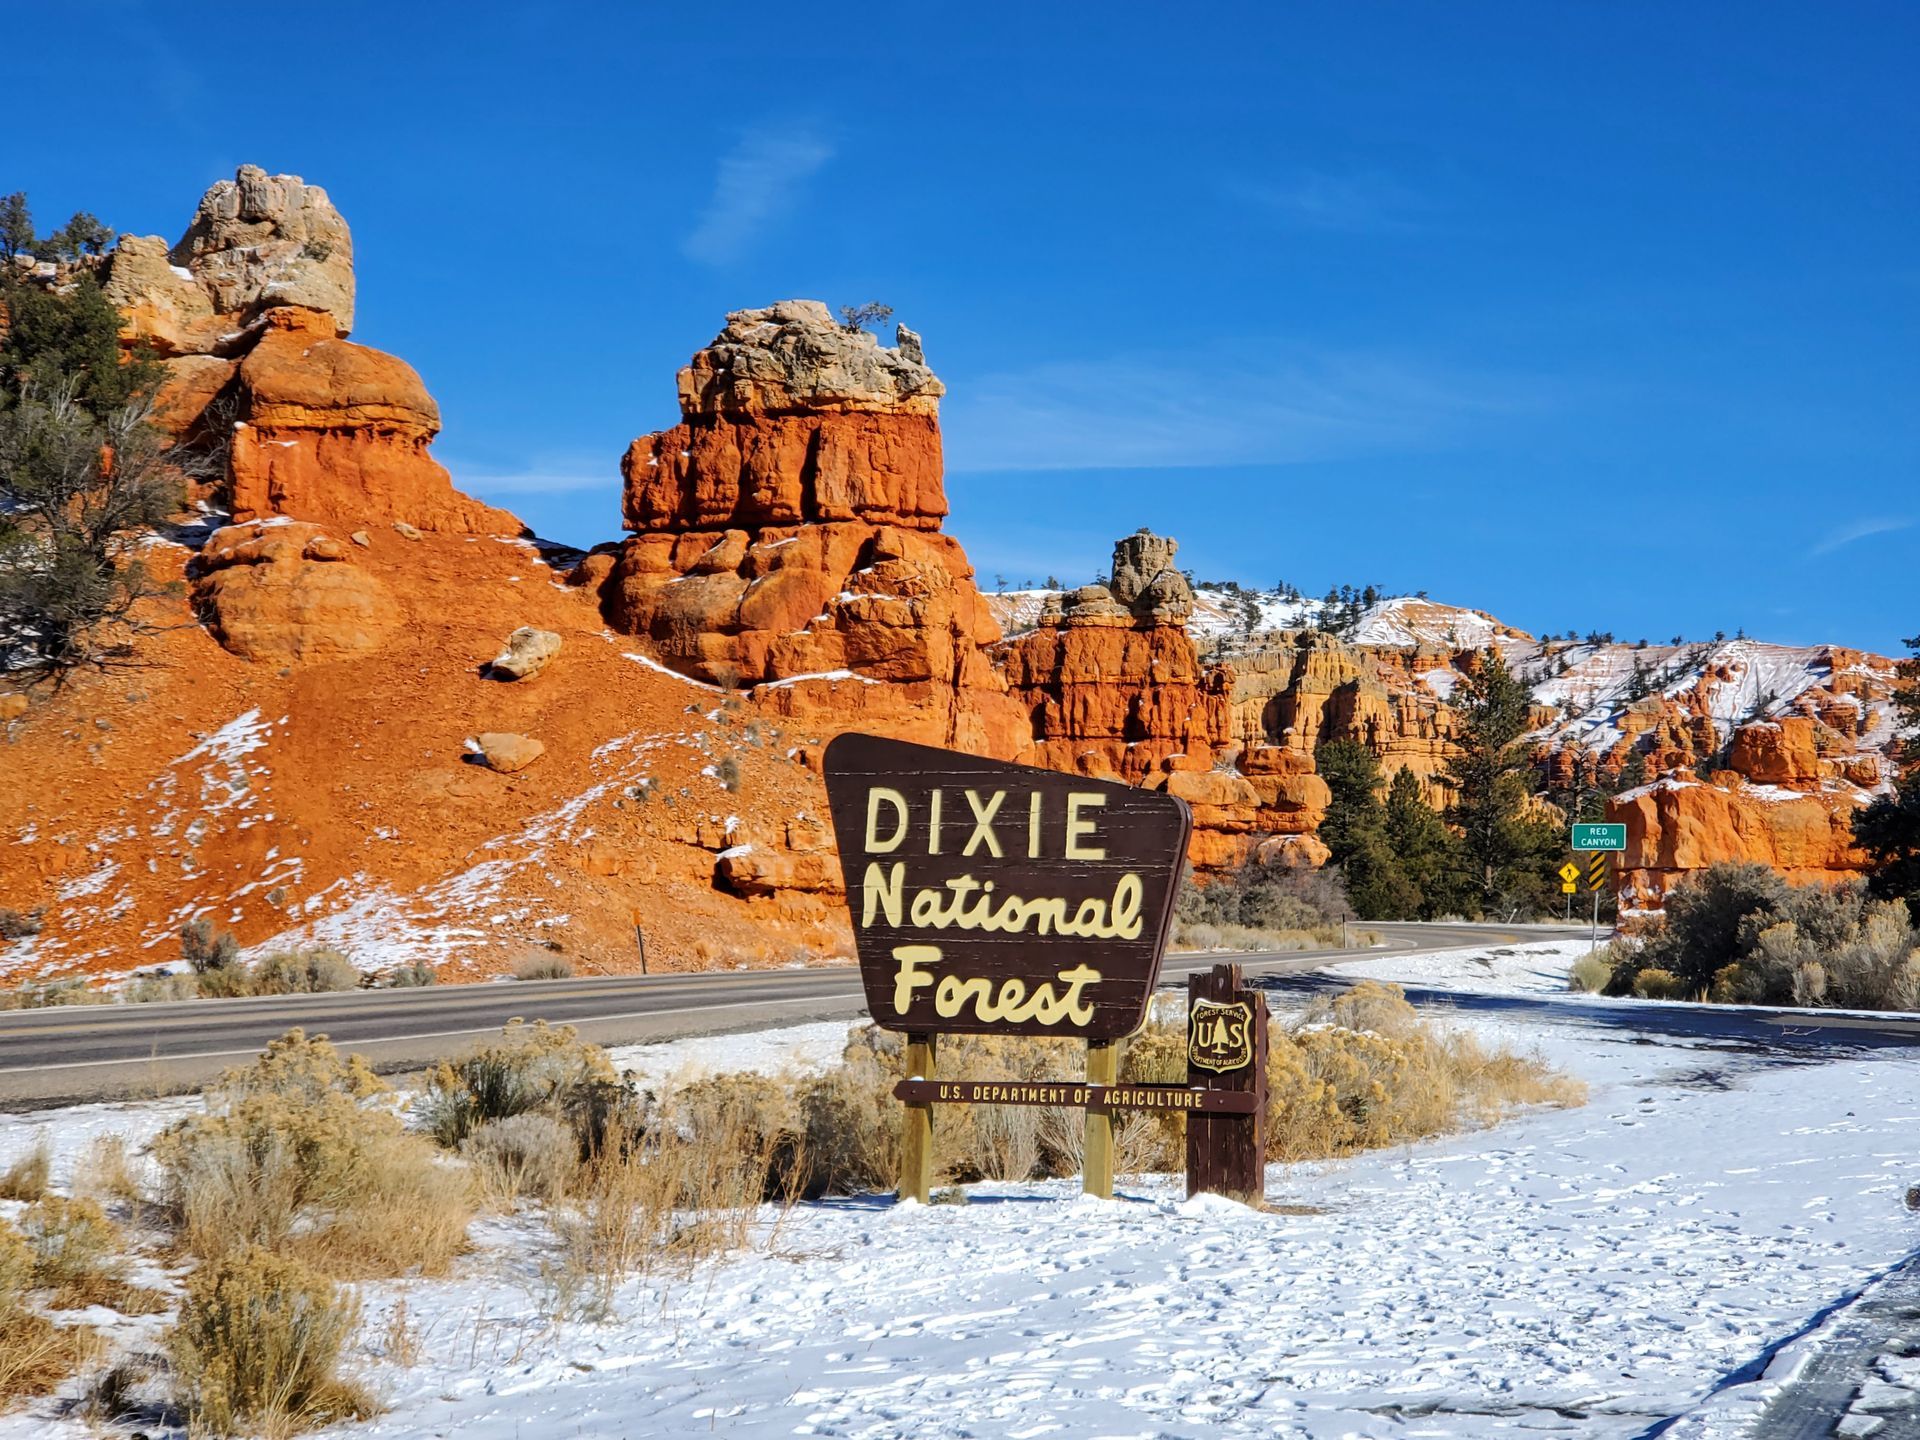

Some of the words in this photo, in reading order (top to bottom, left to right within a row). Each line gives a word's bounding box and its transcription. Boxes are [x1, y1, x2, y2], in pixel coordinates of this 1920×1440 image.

[865, 787, 1106, 860] DIXIE
[1590, 827, 1608, 836] RED
[1581, 838, 1617, 846] CANYON
[861, 862, 1143, 940] National
[892, 945, 1101, 1026] Forest
[1196, 1008, 1218, 1020] FOREST
[1220, 1008, 1245, 1021] SERVICE
[939, 1085, 965, 1100] U.S.
[972, 1086, 1067, 1104] DEPARTMENT
[1073, 1088, 1092, 1104] OF
[1103, 1090, 1204, 1108] AGRICULTURE
